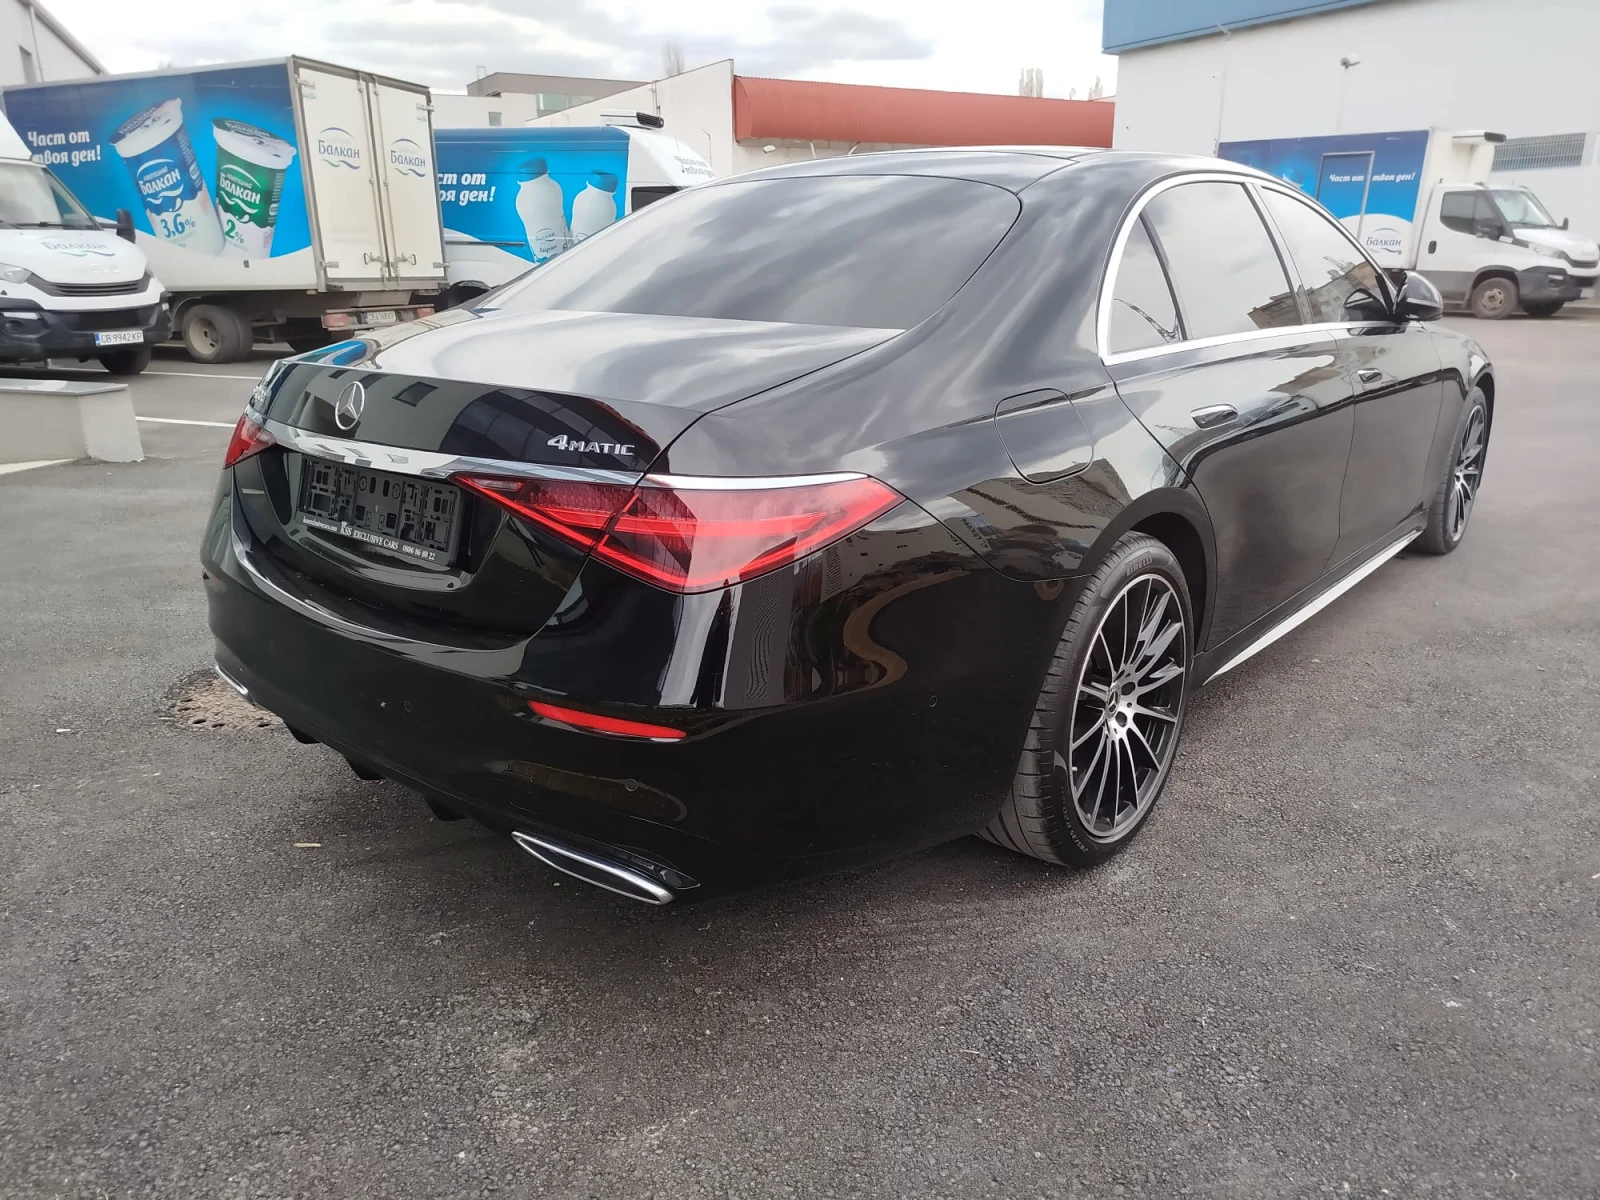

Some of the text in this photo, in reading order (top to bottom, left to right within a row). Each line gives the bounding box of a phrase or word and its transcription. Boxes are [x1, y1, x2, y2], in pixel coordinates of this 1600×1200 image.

[27, 131, 90, 147] Част от
[318, 139, 360, 159] Балкан
[31, 144, 101, 167] твоя ден!
[390, 150, 426, 167] Балкан
[137, 168, 181, 195] Балкан
[437, 173, 486, 186] ст от
[1329, 174, 1350, 182] Част
[1372, 173, 1395, 181] твоя
[1395, 172, 1416, 183] ден!
[219, 172, 261, 205] Балкан
[439, 186, 496, 207] оя ден!
[224, 218, 244, 244] 2%
[1365, 236, 1402, 247] Балкан
[547, 434, 635, 456] 4MATIC
[352, 529, 383, 546] EXCLUSIVE
[383, 539, 399, 551] CARS
[428, 551, 436, 561] 22
